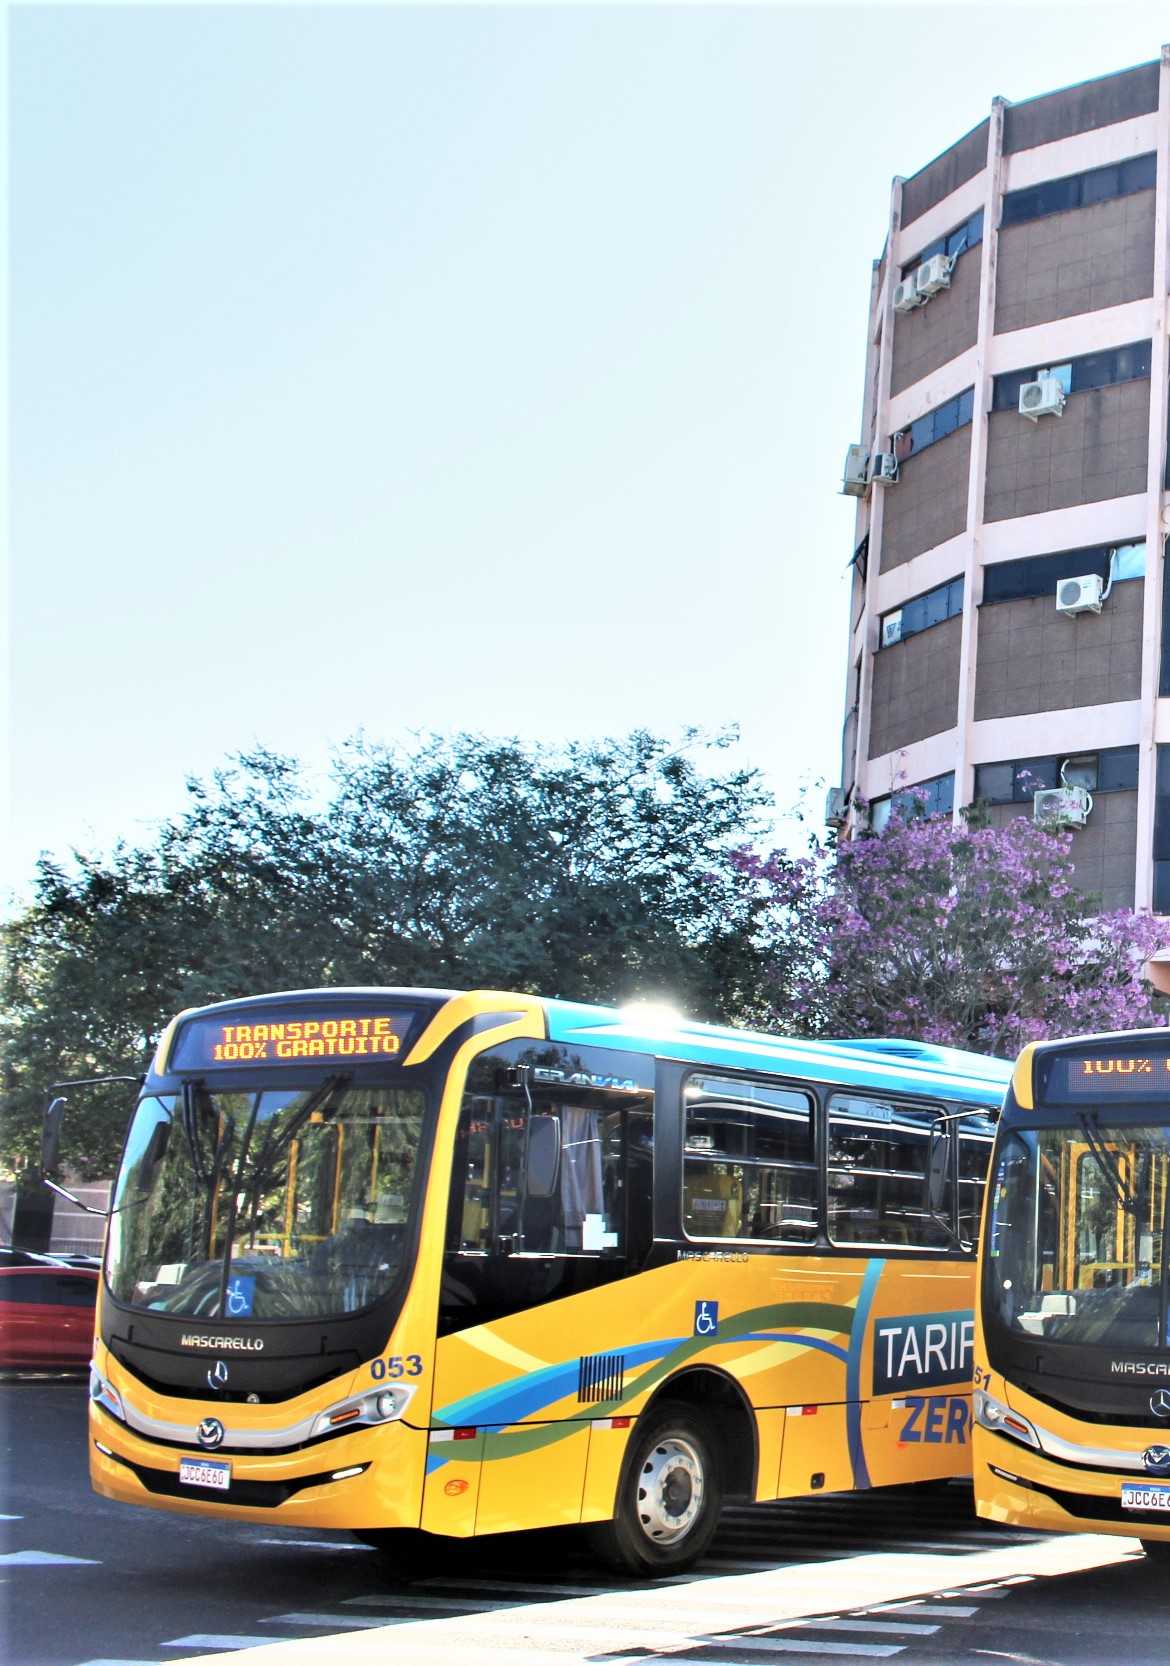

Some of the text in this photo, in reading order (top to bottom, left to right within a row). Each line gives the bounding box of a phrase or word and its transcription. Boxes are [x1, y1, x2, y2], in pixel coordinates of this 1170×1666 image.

[223, 1018, 391, 1043] TRANSPORTE
[214, 1035, 400, 1060] 100% GRATUITO
[534, 1068, 635, 1090] GRANVIA
[677, 1250, 749, 1262] MASCARELLO
[181, 1334, 264, 1350] MASCARELLO
[879, 1320, 975, 1378] TARIF
[370, 1355, 423, 1380] 053
[973, 1366, 992, 1391] 51
[899, 1396, 973, 1444] ZER
